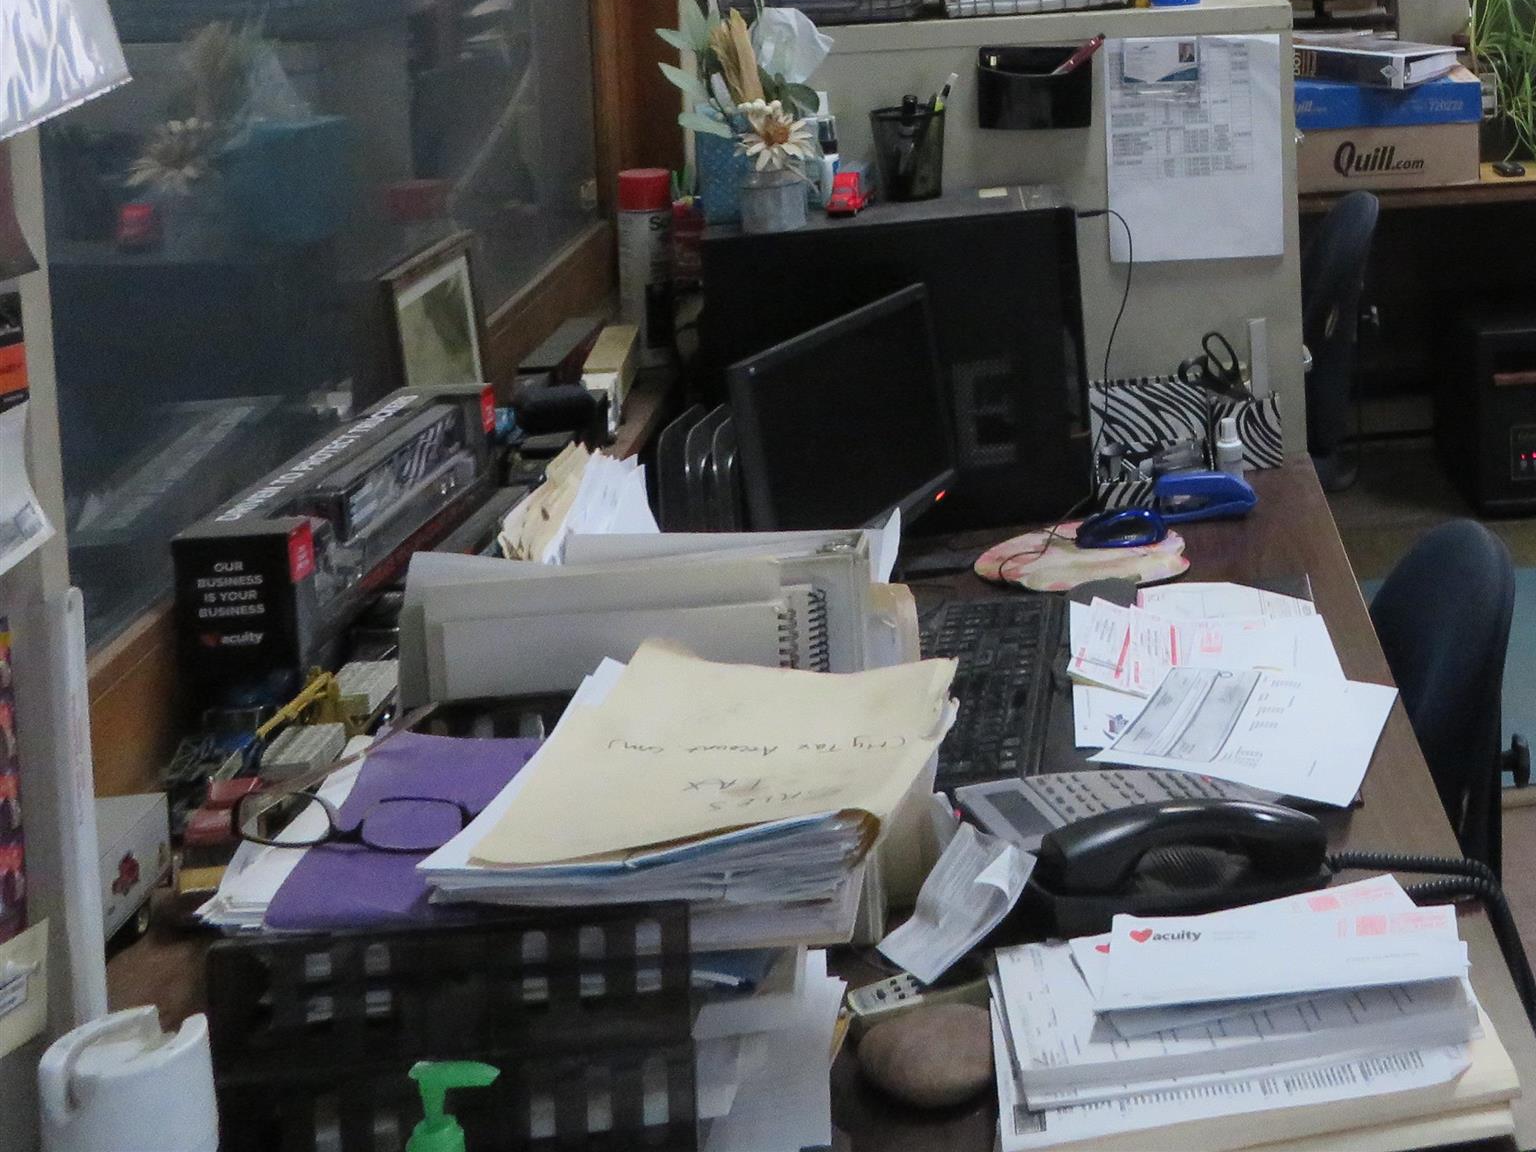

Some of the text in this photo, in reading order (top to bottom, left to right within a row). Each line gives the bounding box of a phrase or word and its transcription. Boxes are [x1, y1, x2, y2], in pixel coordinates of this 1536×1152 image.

[1333, 141, 1425, 178] Quill.com
[269, 472, 305, 486] TO
[289, 434, 361, 472] PROTECT
[213, 560, 244, 573] OUR
[197, 575, 263, 589] BUSINESS
[203, 589, 258, 603] IS YOUR
[198, 603, 266, 618] BUSINESS
[222, 631, 264, 645] acuity
[1152, 930, 1202, 942] acuity
